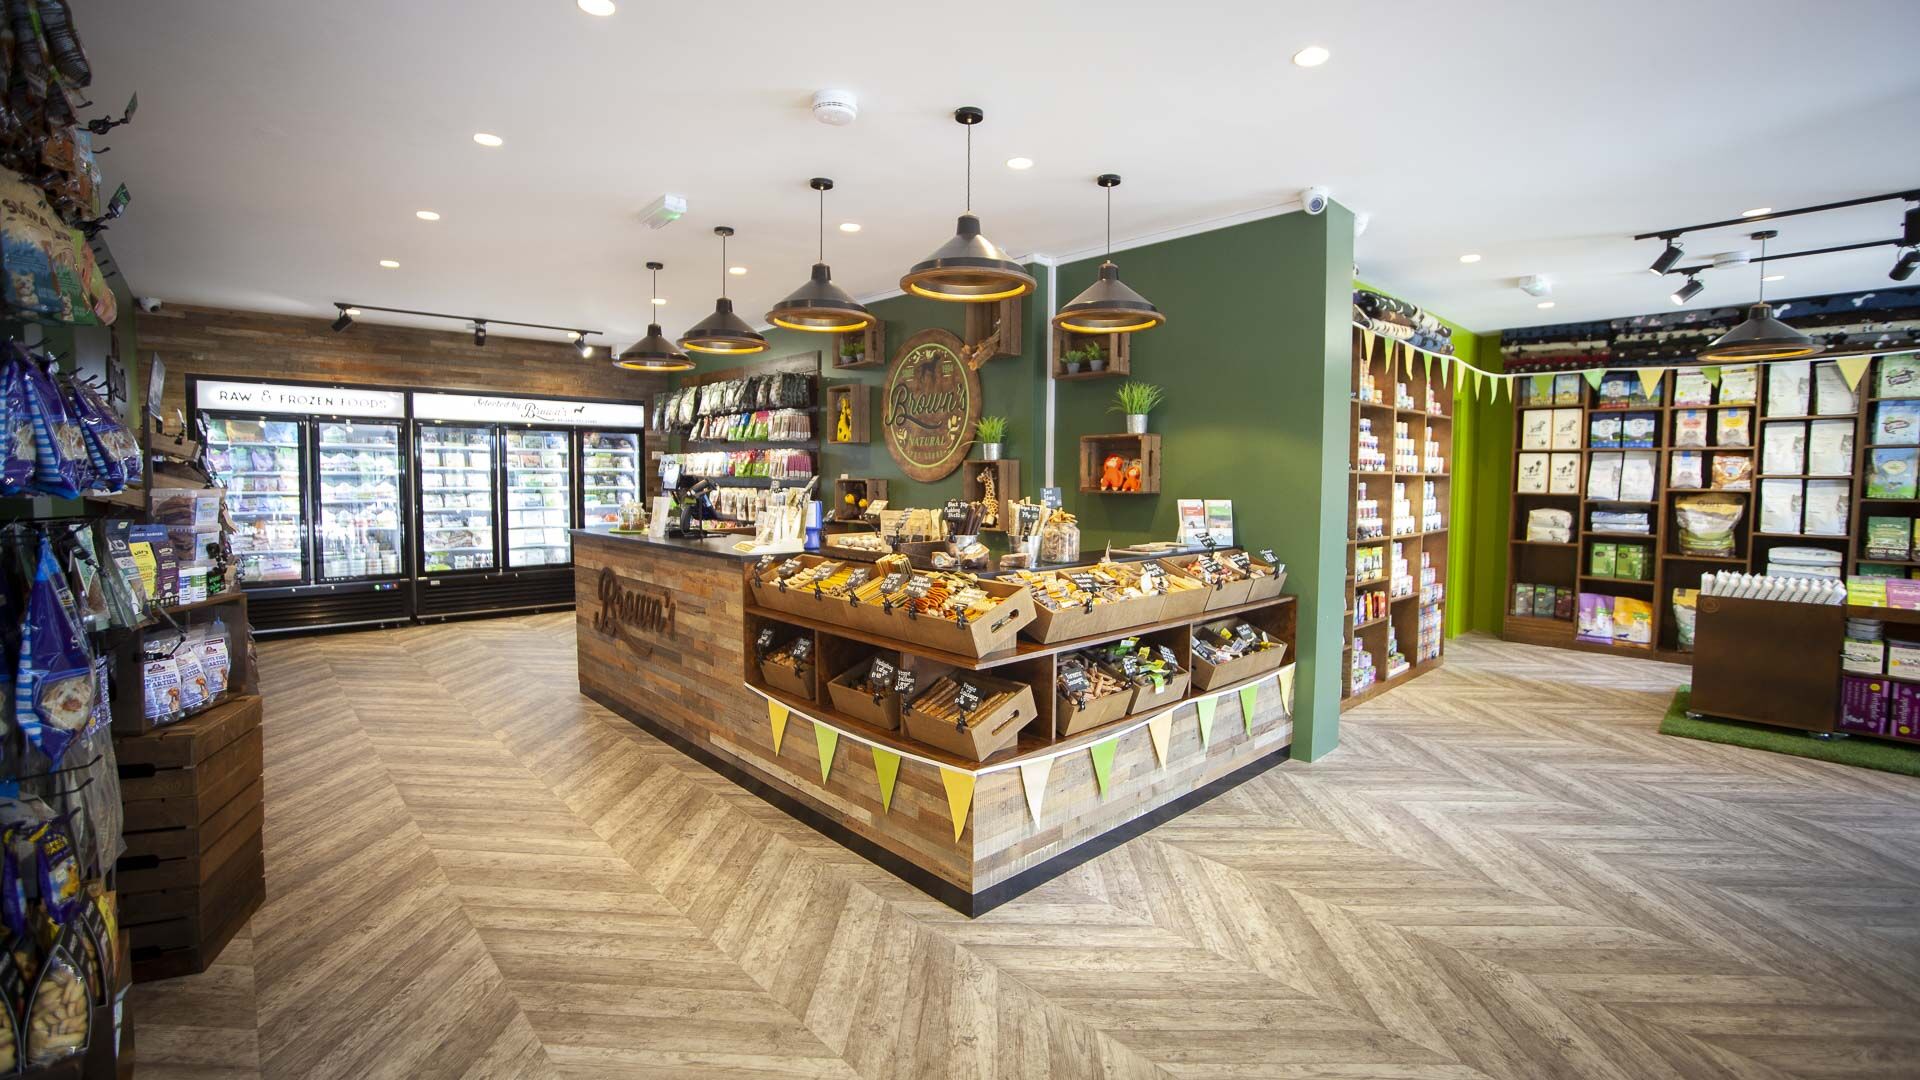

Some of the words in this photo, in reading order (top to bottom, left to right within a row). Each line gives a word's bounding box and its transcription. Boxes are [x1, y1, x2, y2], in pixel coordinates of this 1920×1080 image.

[219, 390, 252, 401] RAW
[261, 389, 272, 401] &
[279, 393, 334, 406] FROZEN
[341, 397, 387, 409] FOODS
[884, 383, 966, 430] Brown's
[908, 434, 945, 447] NATURAL
[593, 566, 678, 658] Brown's
